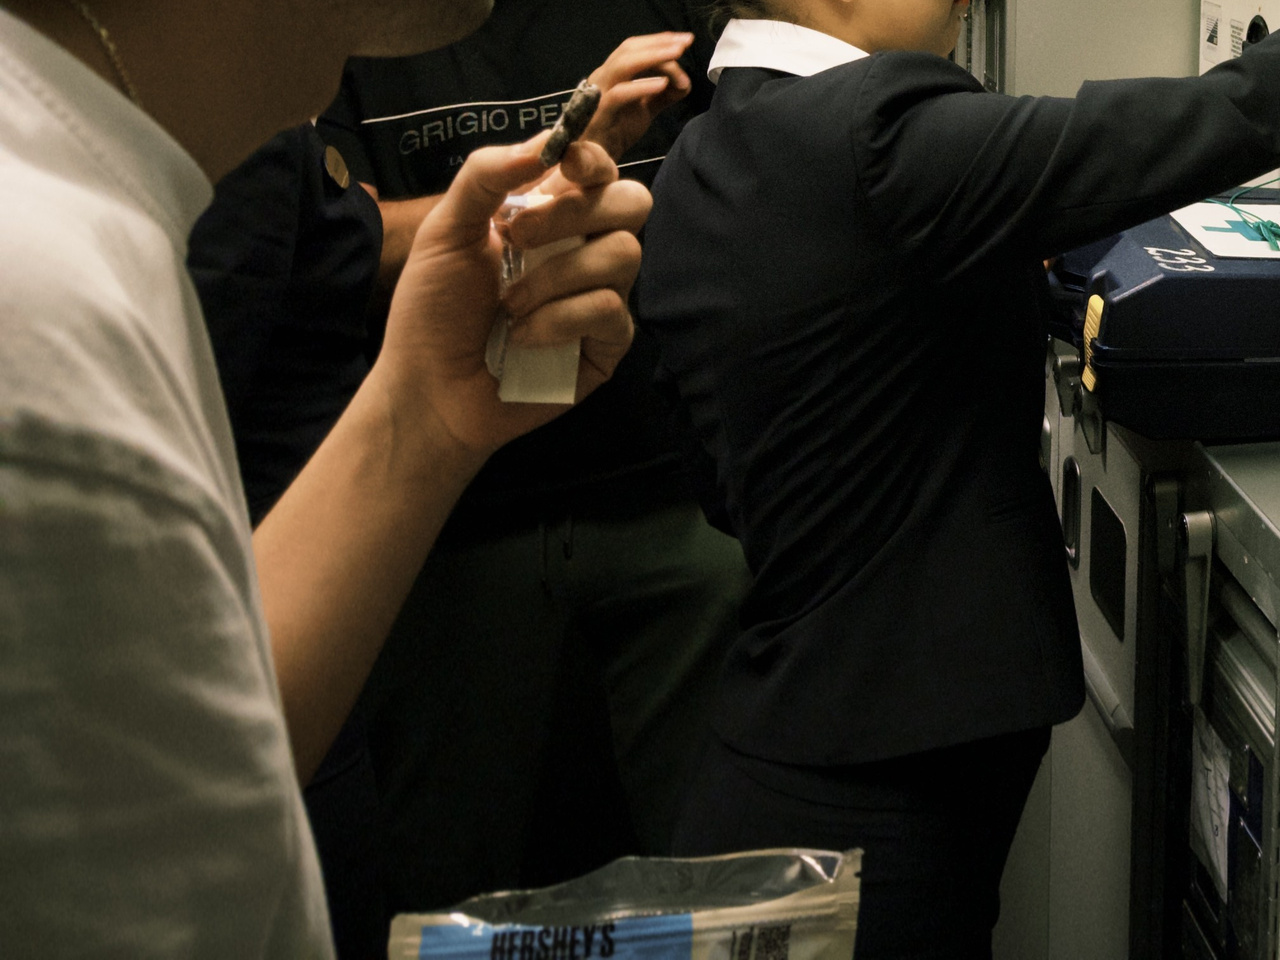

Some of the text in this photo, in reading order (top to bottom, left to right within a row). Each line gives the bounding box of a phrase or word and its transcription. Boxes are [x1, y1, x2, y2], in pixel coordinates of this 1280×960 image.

[399, 102, 571, 156] GRIGIO PE
[1144, 245, 1215, 272] 233
[489, 923, 616, 960] HERSHEY'S
